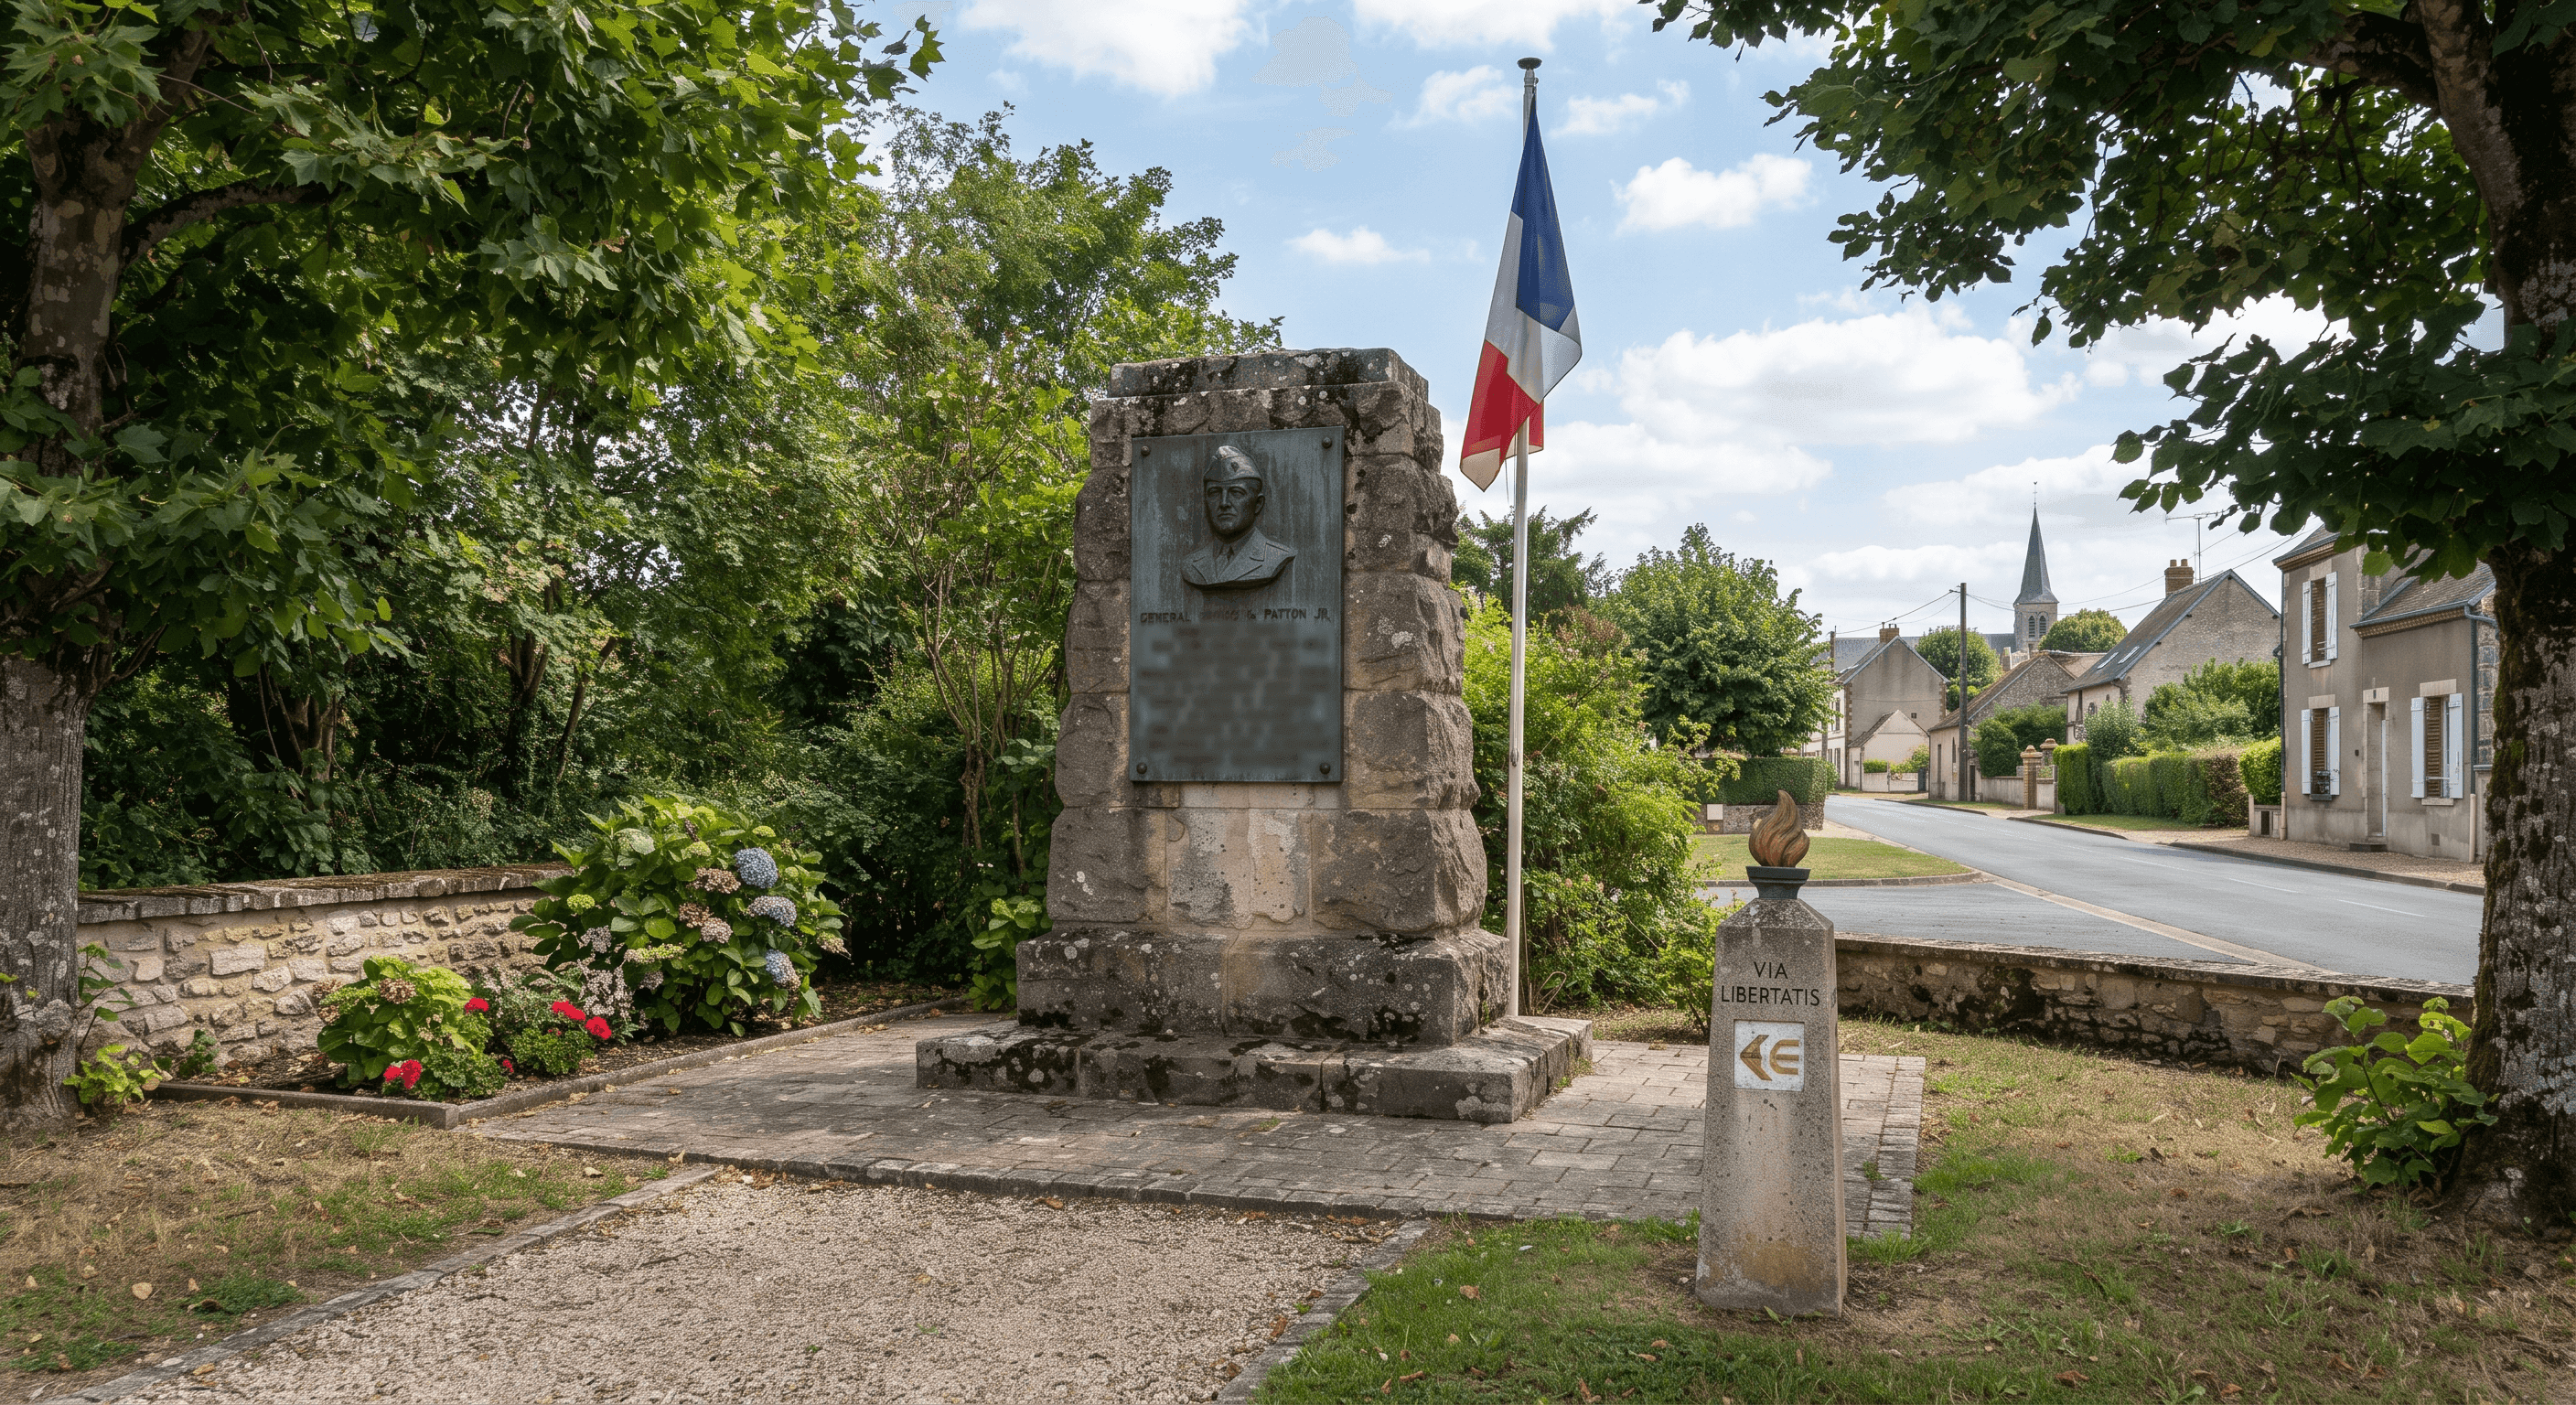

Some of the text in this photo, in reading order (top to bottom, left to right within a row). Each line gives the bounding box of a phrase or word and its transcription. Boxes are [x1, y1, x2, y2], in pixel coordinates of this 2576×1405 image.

[1263, 608, 1307, 620] PATTON
[1753, 961, 1788, 980] VIA
[1721, 985, 1820, 1006] LIBERTATIS
